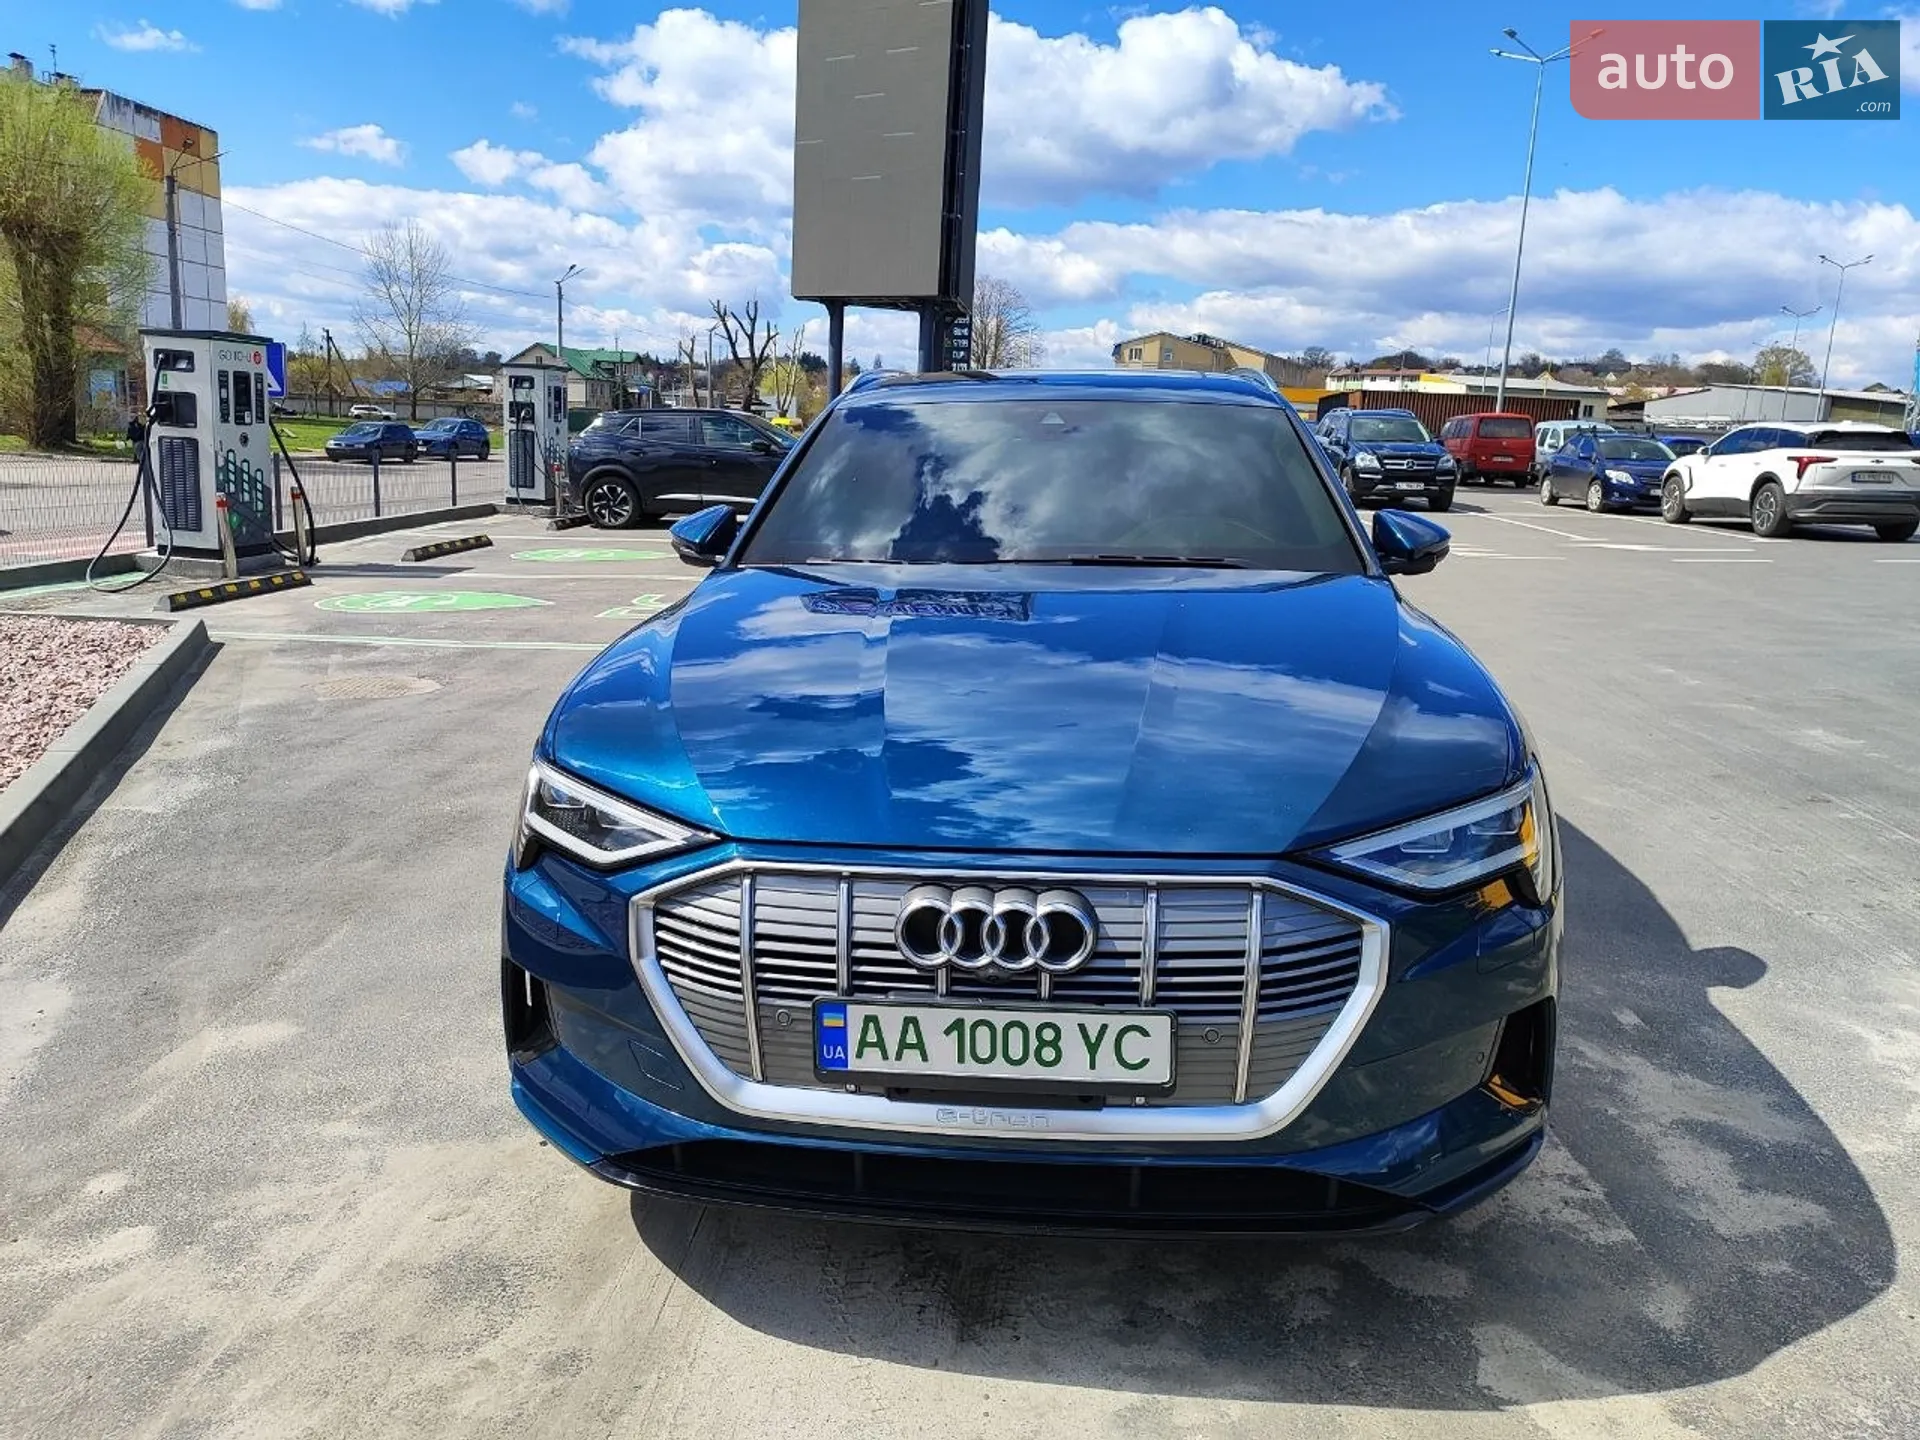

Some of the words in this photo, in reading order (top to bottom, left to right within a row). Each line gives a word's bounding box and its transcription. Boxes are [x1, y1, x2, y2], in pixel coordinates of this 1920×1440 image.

[823, 1044, 846, 1060] UA
[855, 1014, 929, 1063] AA
[943, 1017, 1062, 1068] 1008
[1077, 1022, 1151, 1071] YC
[936, 1107, 1051, 1127] e-tron
